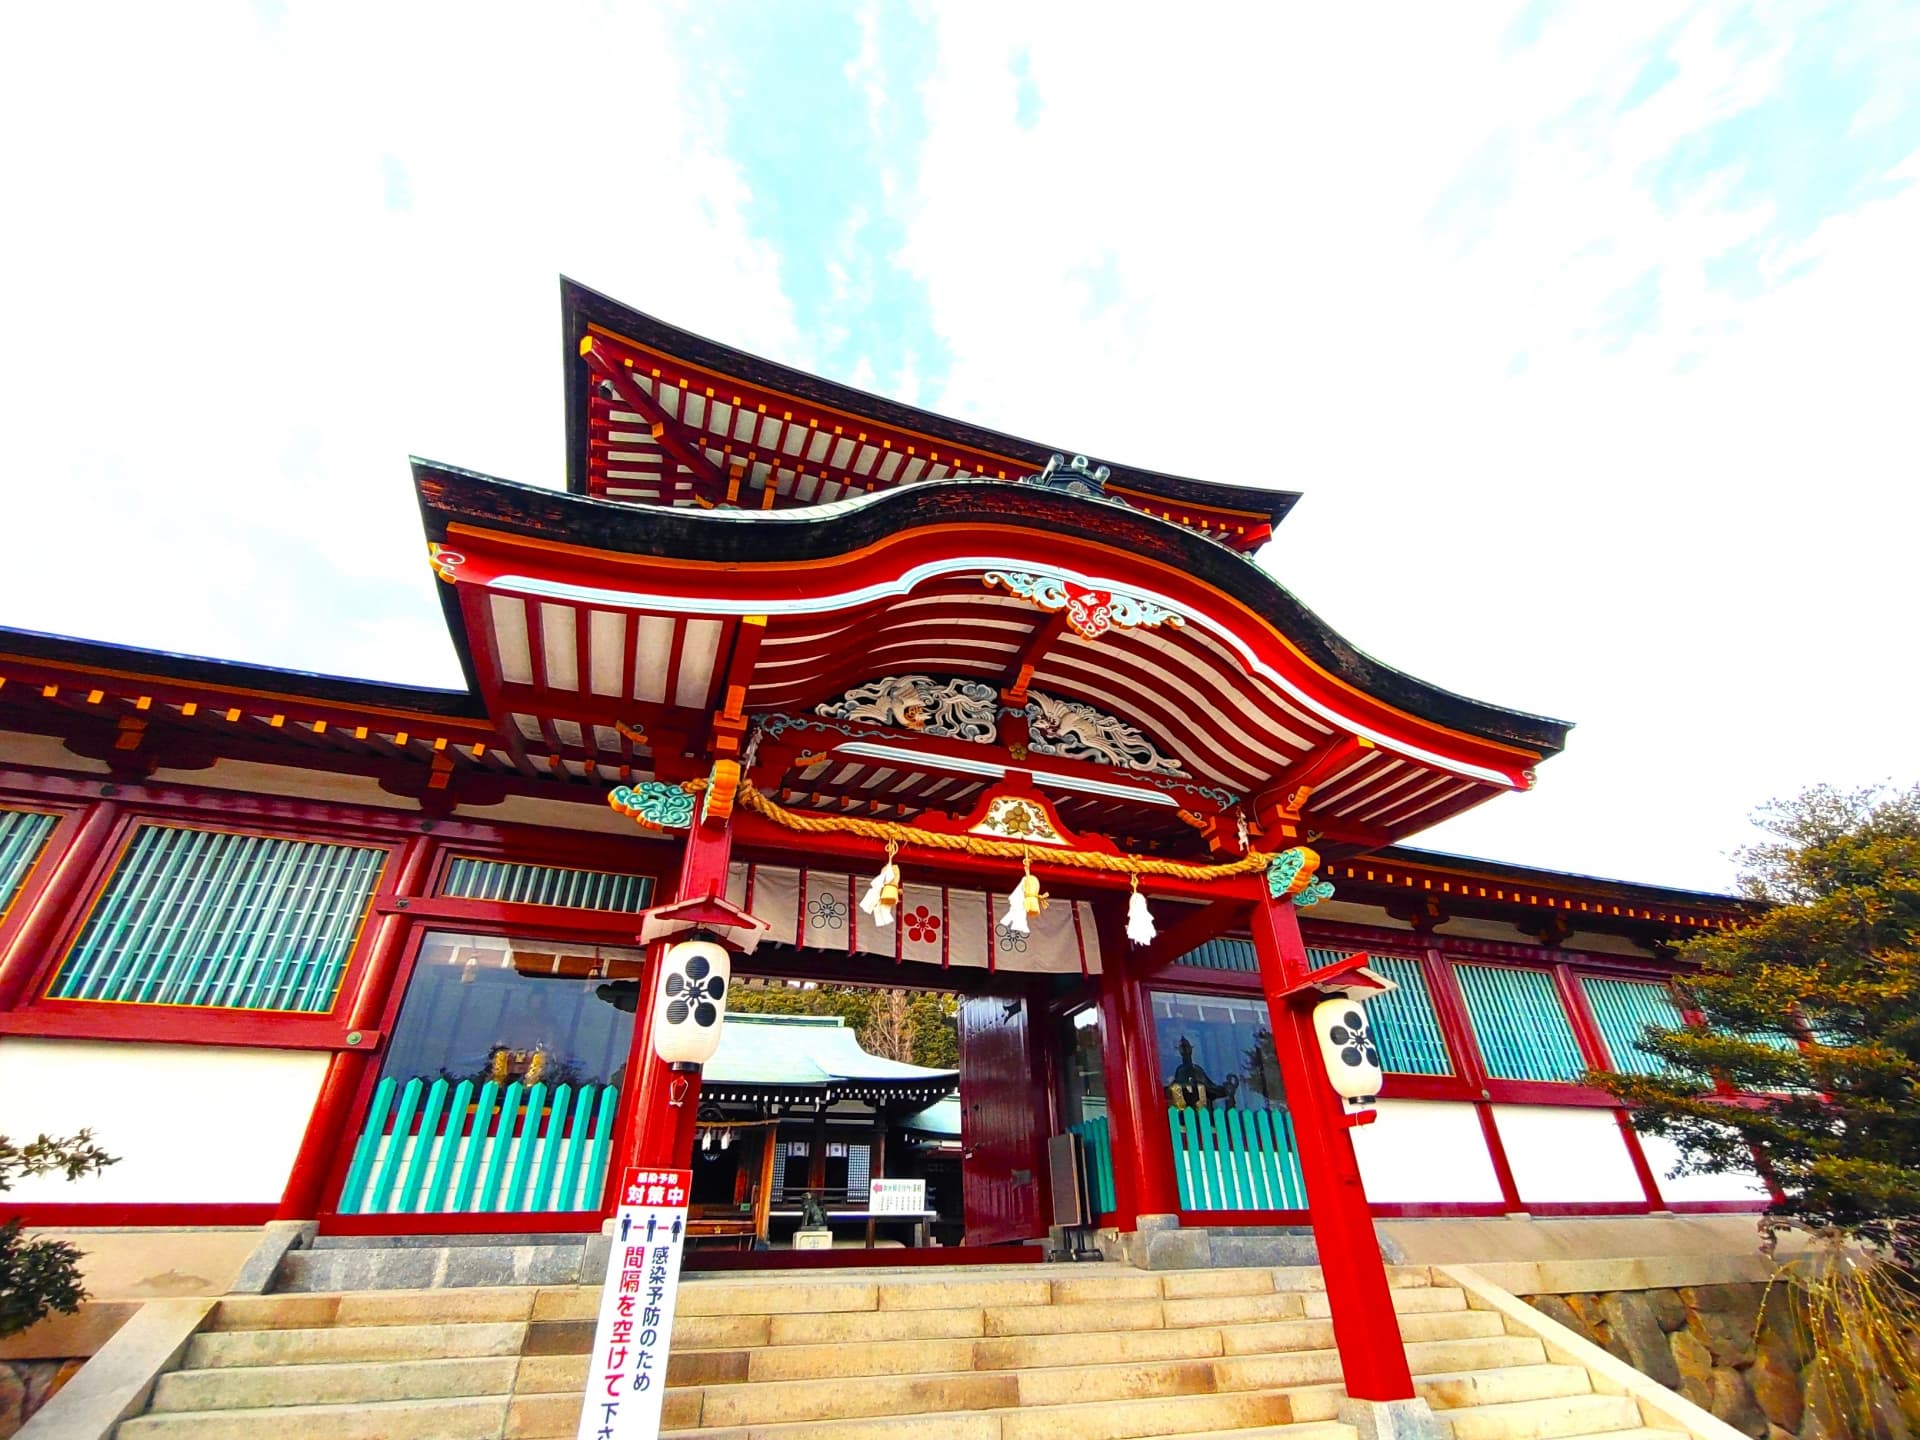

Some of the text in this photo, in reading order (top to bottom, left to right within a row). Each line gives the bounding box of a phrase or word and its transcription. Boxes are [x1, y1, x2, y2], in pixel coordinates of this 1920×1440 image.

[637, 1172, 679, 1185] 感染予防
[626, 1184, 684, 1205] 対策中
[633, 1246, 670, 1392] 感染予防のため
